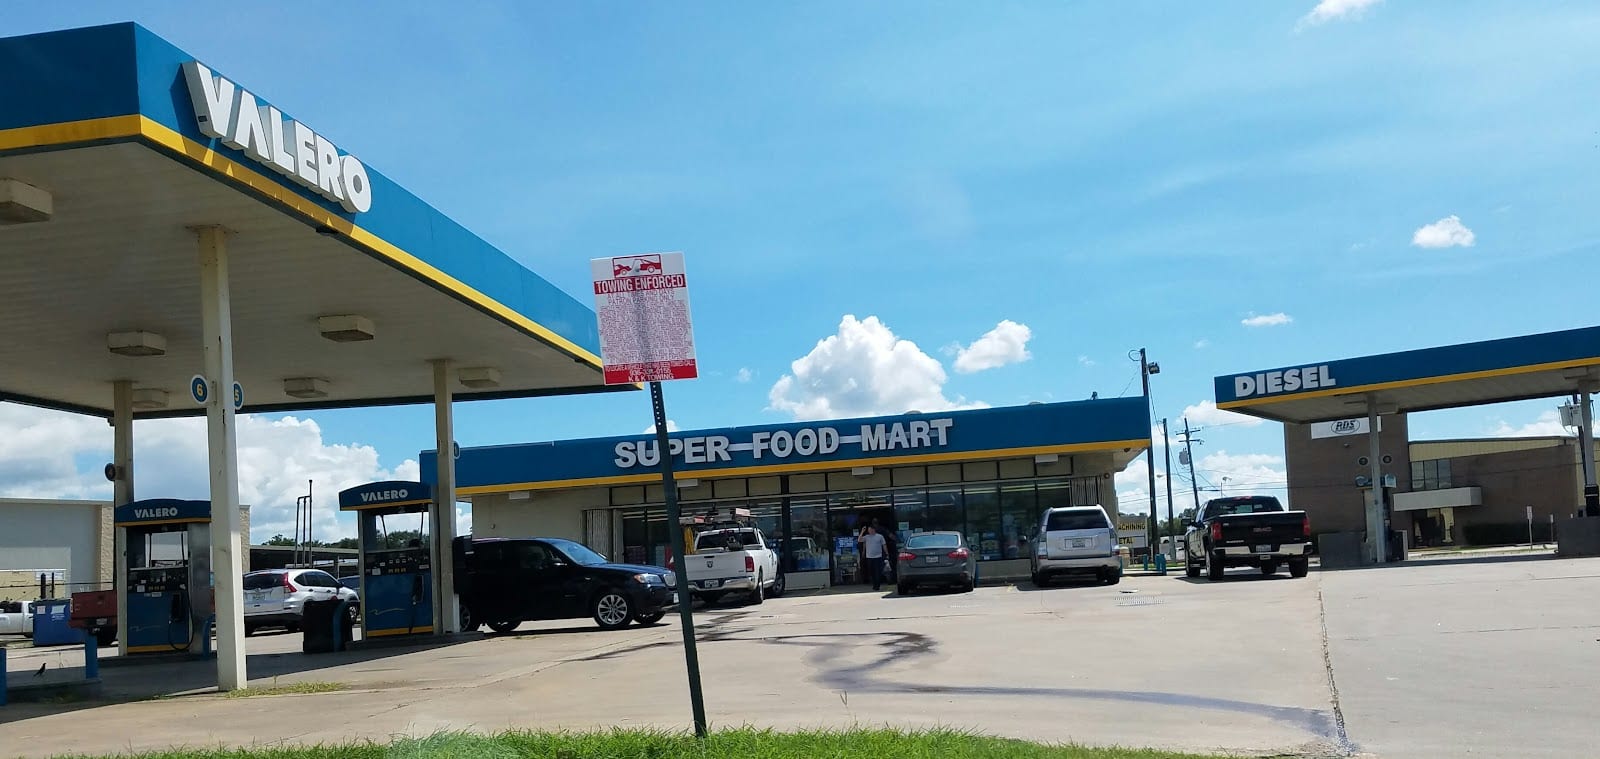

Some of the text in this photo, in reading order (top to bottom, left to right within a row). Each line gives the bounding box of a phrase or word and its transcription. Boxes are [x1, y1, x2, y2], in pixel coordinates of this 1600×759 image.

[183, 60, 371, 213] VALERO
[596, 275, 684, 293] TOWING ENFORCED
[647, 372, 675, 381] TOWING
[1234, 365, 1336, 397] DIESEL
[614, 418, 953, 468] SUPER FOOD MART
[360, 489, 409, 502] VALERO
[134, 507, 179, 519] VALERO
